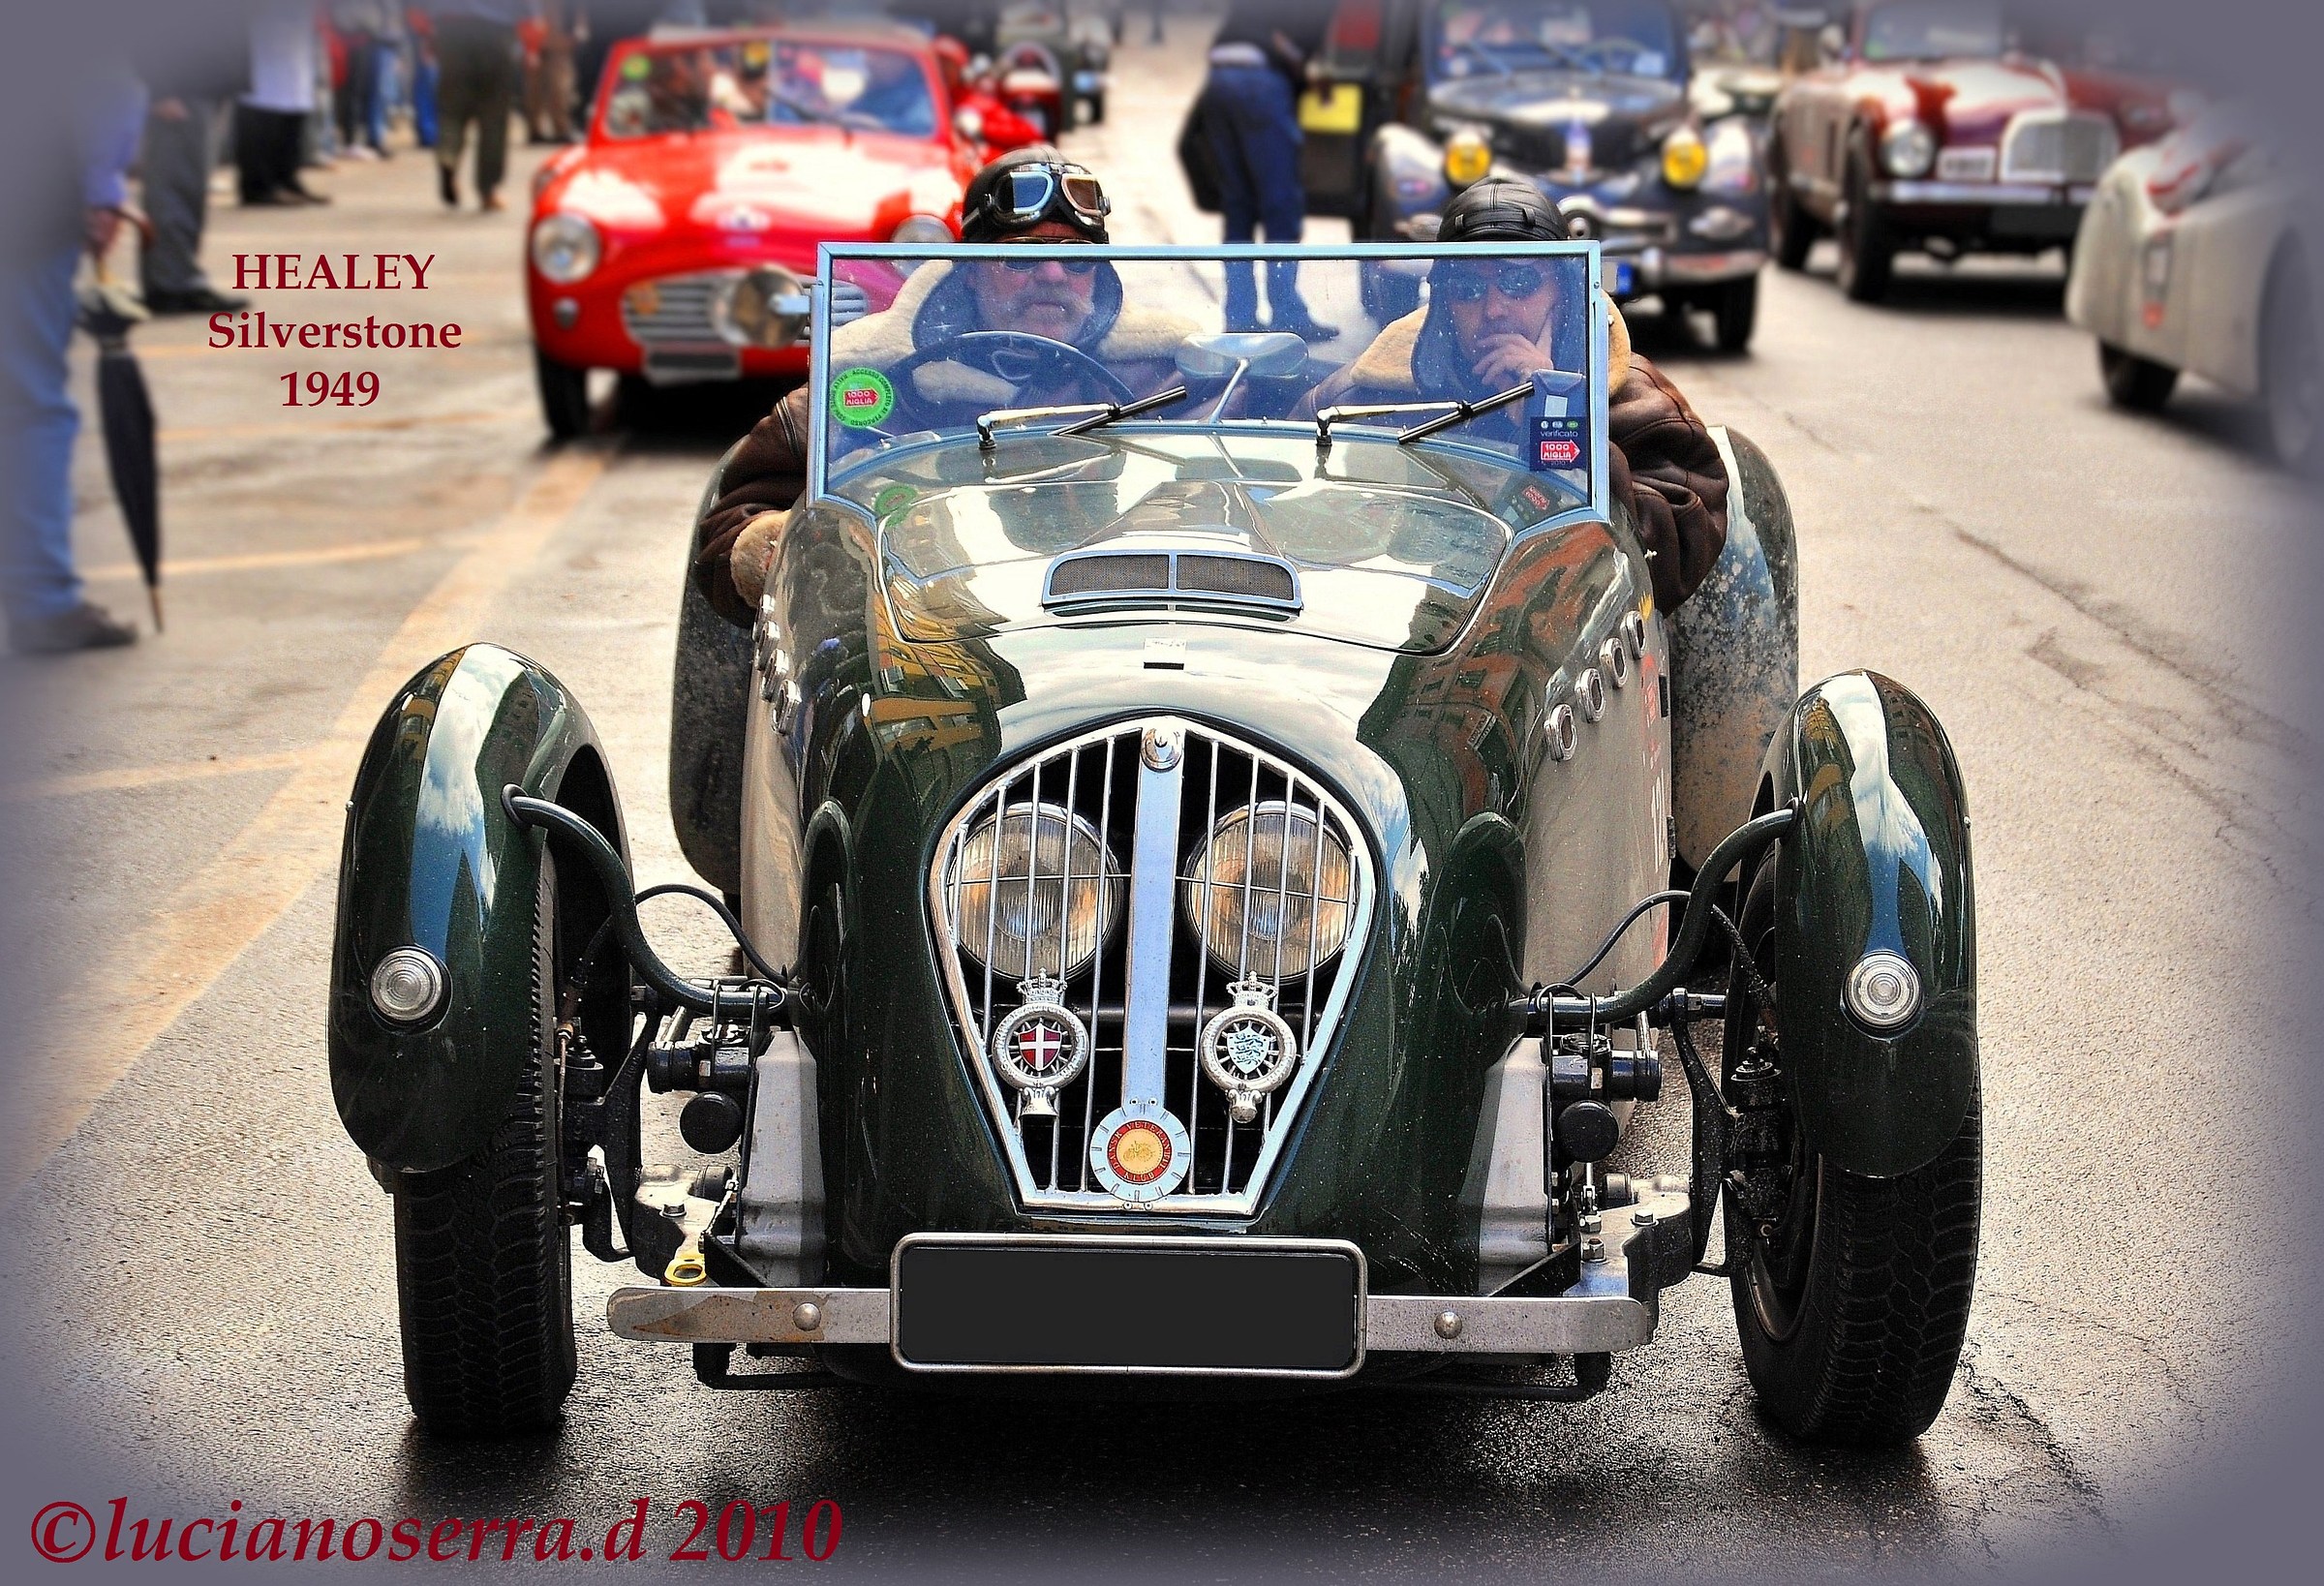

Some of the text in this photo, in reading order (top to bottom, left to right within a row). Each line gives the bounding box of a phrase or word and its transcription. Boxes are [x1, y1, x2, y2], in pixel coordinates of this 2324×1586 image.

[1540, 429, 1578, 438] verificato
[1108, 1131, 1123, 1170] DANSK
[1123, 1172, 1156, 1181] KLUB
